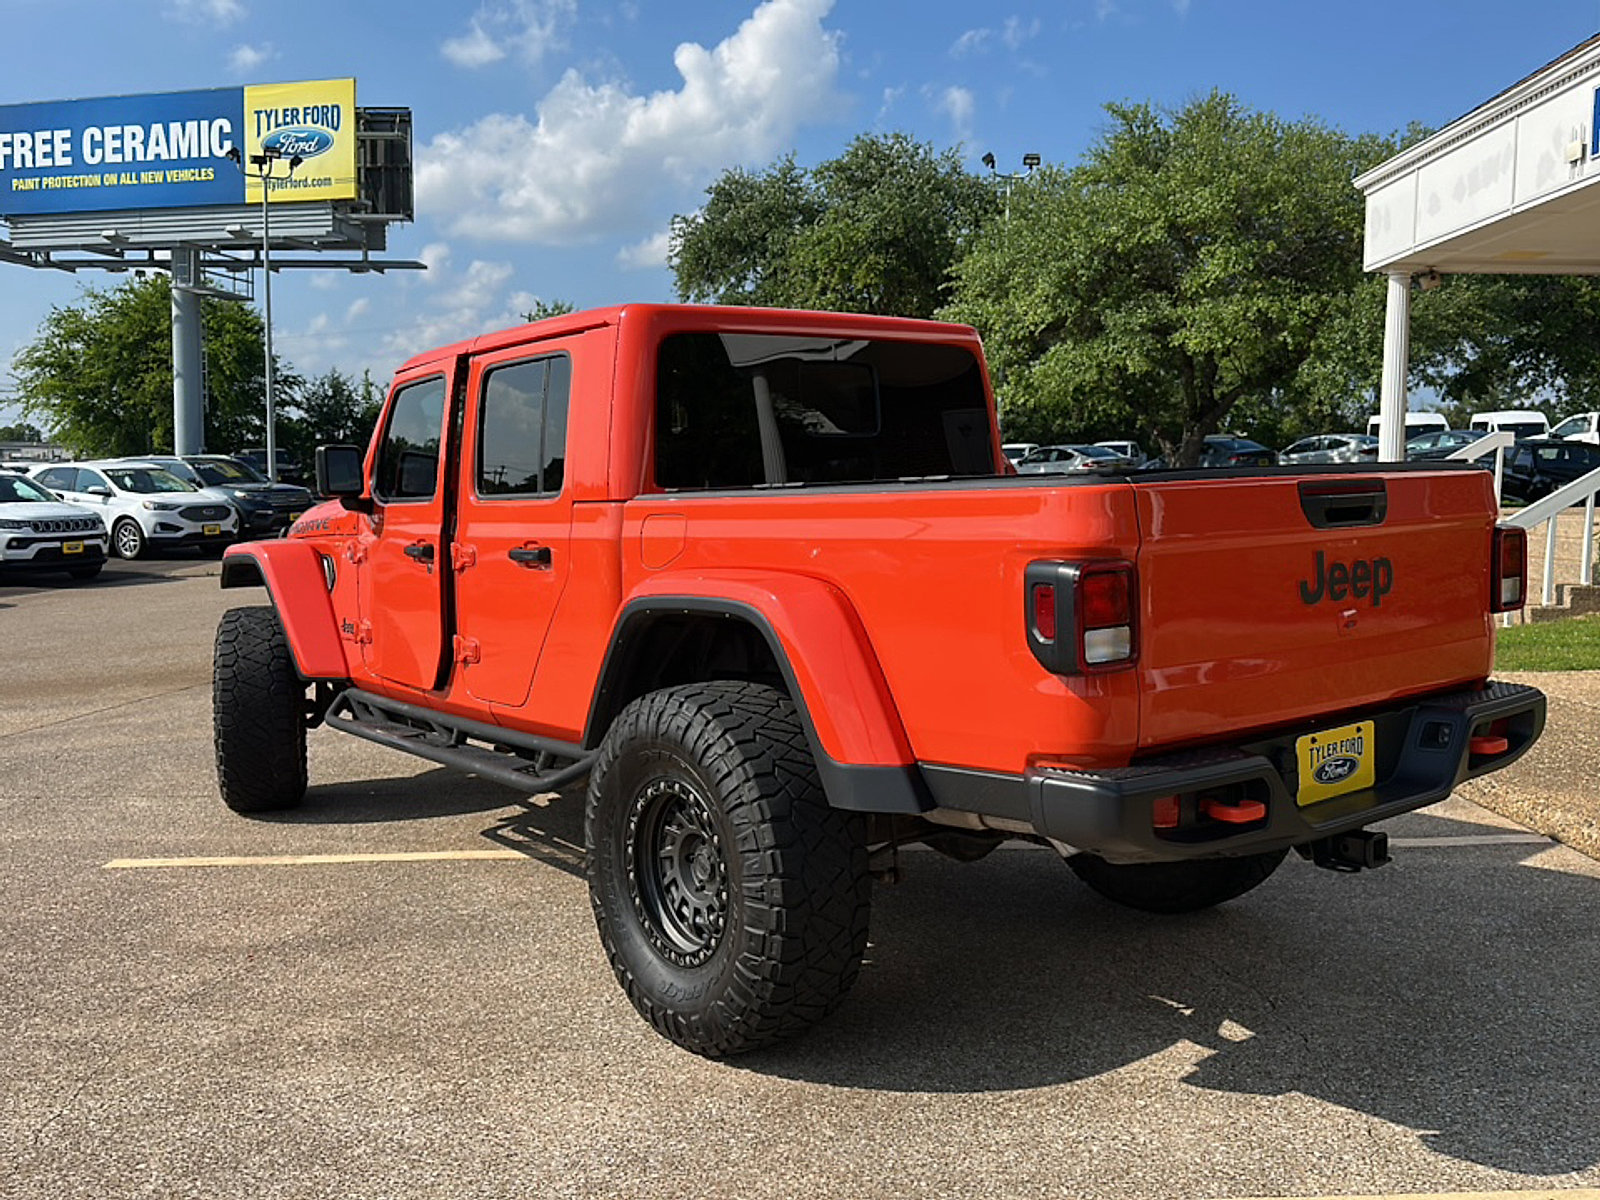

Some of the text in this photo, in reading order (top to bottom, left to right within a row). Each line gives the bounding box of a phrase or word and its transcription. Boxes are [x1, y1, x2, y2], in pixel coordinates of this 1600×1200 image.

[253, 104, 341, 138] TYLER FORD
[0, 118, 233, 170] FREE CERAMIC
[276, 132, 319, 152] Ford
[12, 167, 215, 191] PAINT PROTECTION ON ALL NEW VEHICLES
[1299, 550, 1393, 608] Jeep
[1309, 736, 1363, 770] TYLER FORD
[1321, 760, 1351, 780] Ford
